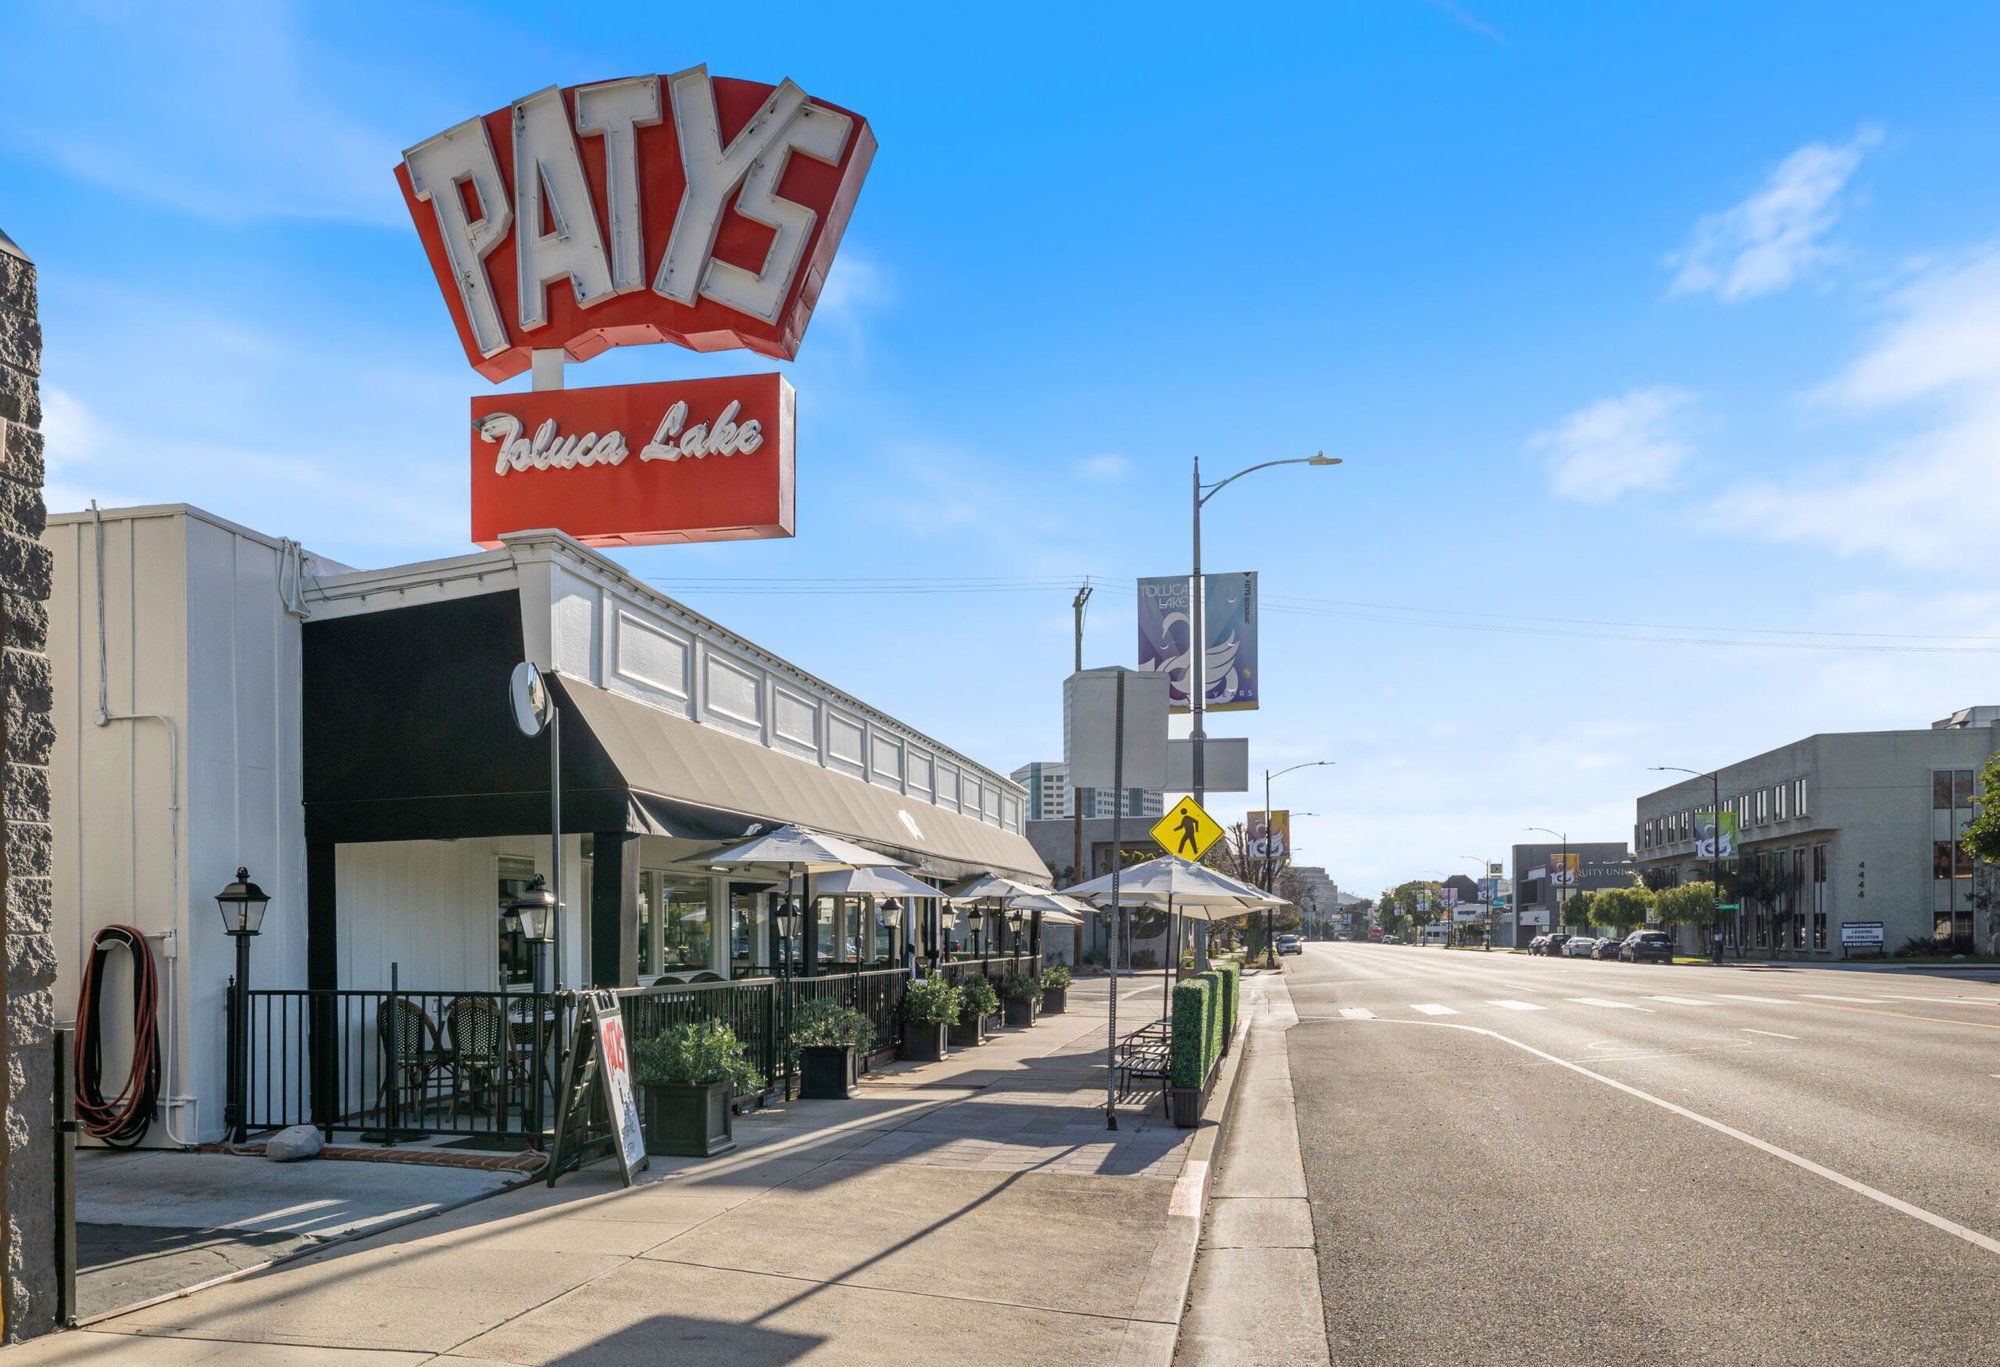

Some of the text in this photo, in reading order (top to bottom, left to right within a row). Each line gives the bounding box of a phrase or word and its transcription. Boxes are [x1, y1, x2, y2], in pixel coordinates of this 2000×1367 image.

[402, 62, 853, 360] PATYS
[475, 400, 763, 476] Toluca Lake
[1140, 583, 1189, 598] TOLUCA
[1159, 596, 1188, 609] LAKE
[1213, 689, 1254, 698] YEARS
